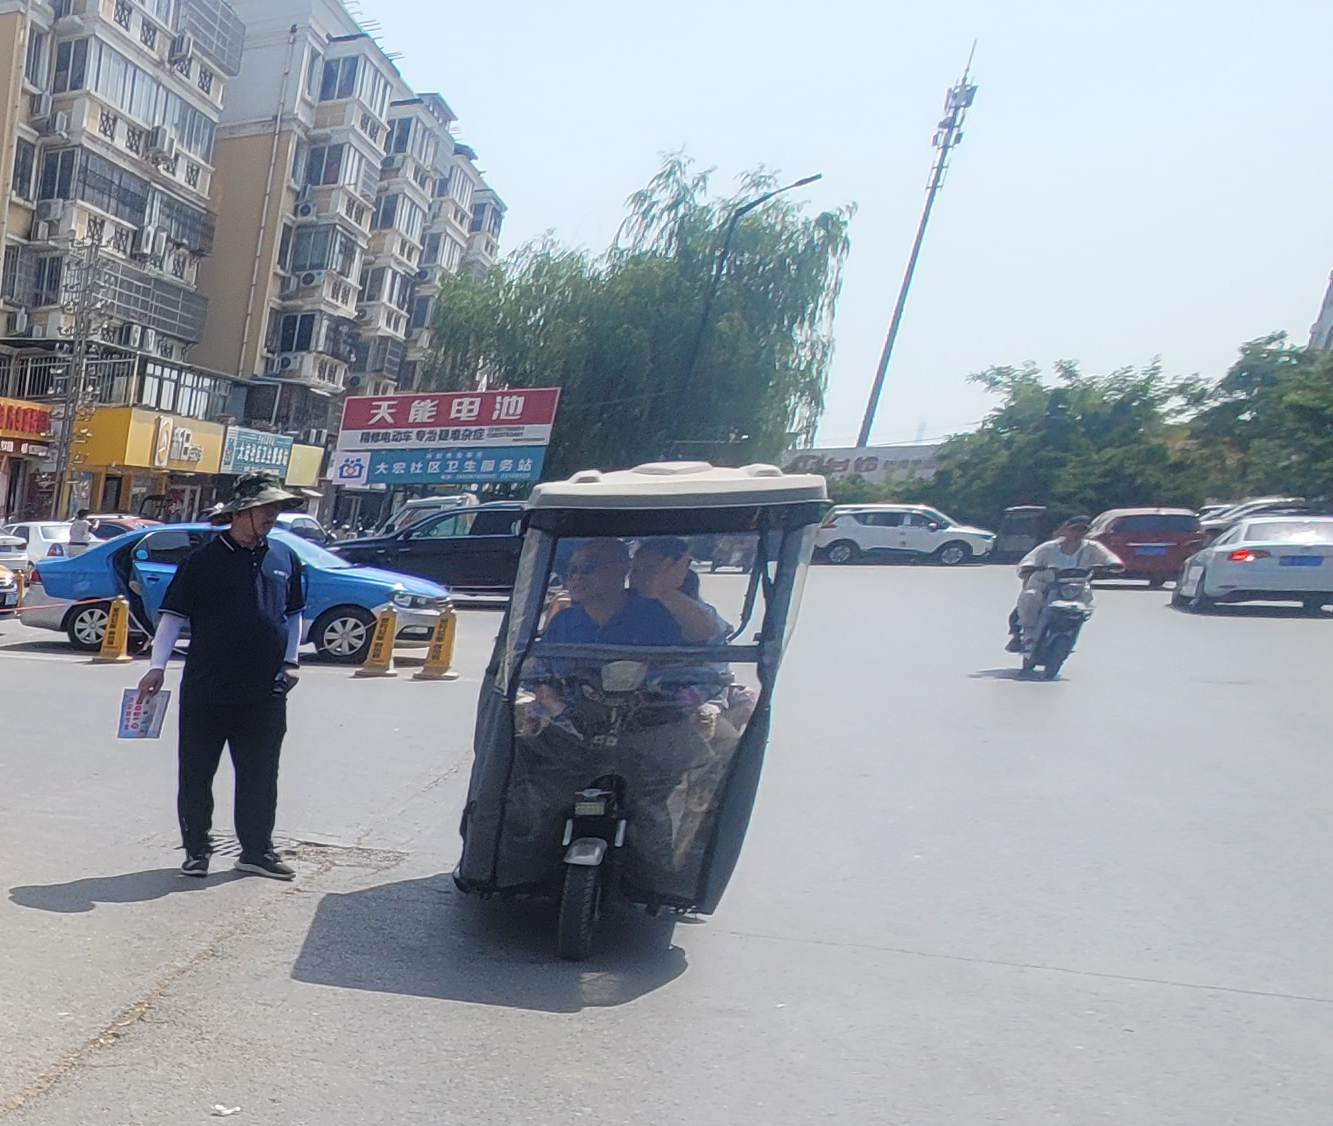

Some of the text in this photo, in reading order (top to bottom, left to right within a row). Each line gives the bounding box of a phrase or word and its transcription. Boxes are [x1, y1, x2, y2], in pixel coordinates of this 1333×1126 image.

[367, 395, 526, 426] 天能电池
[415, 427, 486, 442] 专治疑难杂症
[374, 458, 534, 475] 大宏社区卫生服务站
